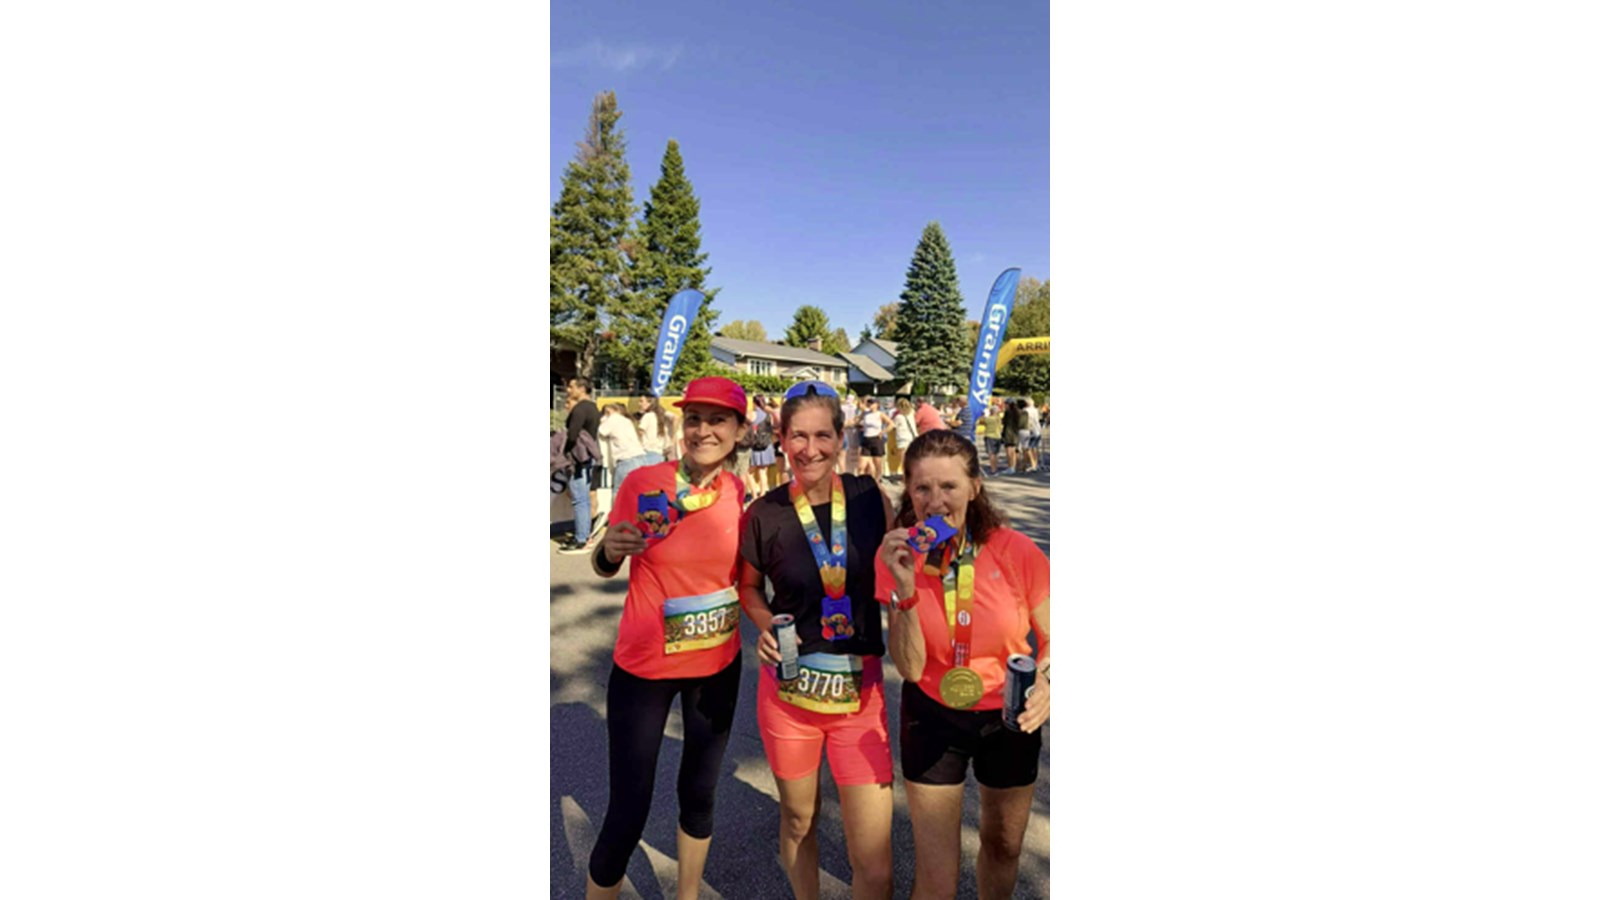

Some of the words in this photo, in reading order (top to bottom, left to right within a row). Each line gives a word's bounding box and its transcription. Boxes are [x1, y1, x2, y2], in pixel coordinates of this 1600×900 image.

[654, 314, 687, 397] Granby
[972, 303, 1007, 405] Granby
[1016, 341, 1050, 351] ARRI
[684, 607, 727, 636] 3357
[798, 668, 844, 697] 3770
